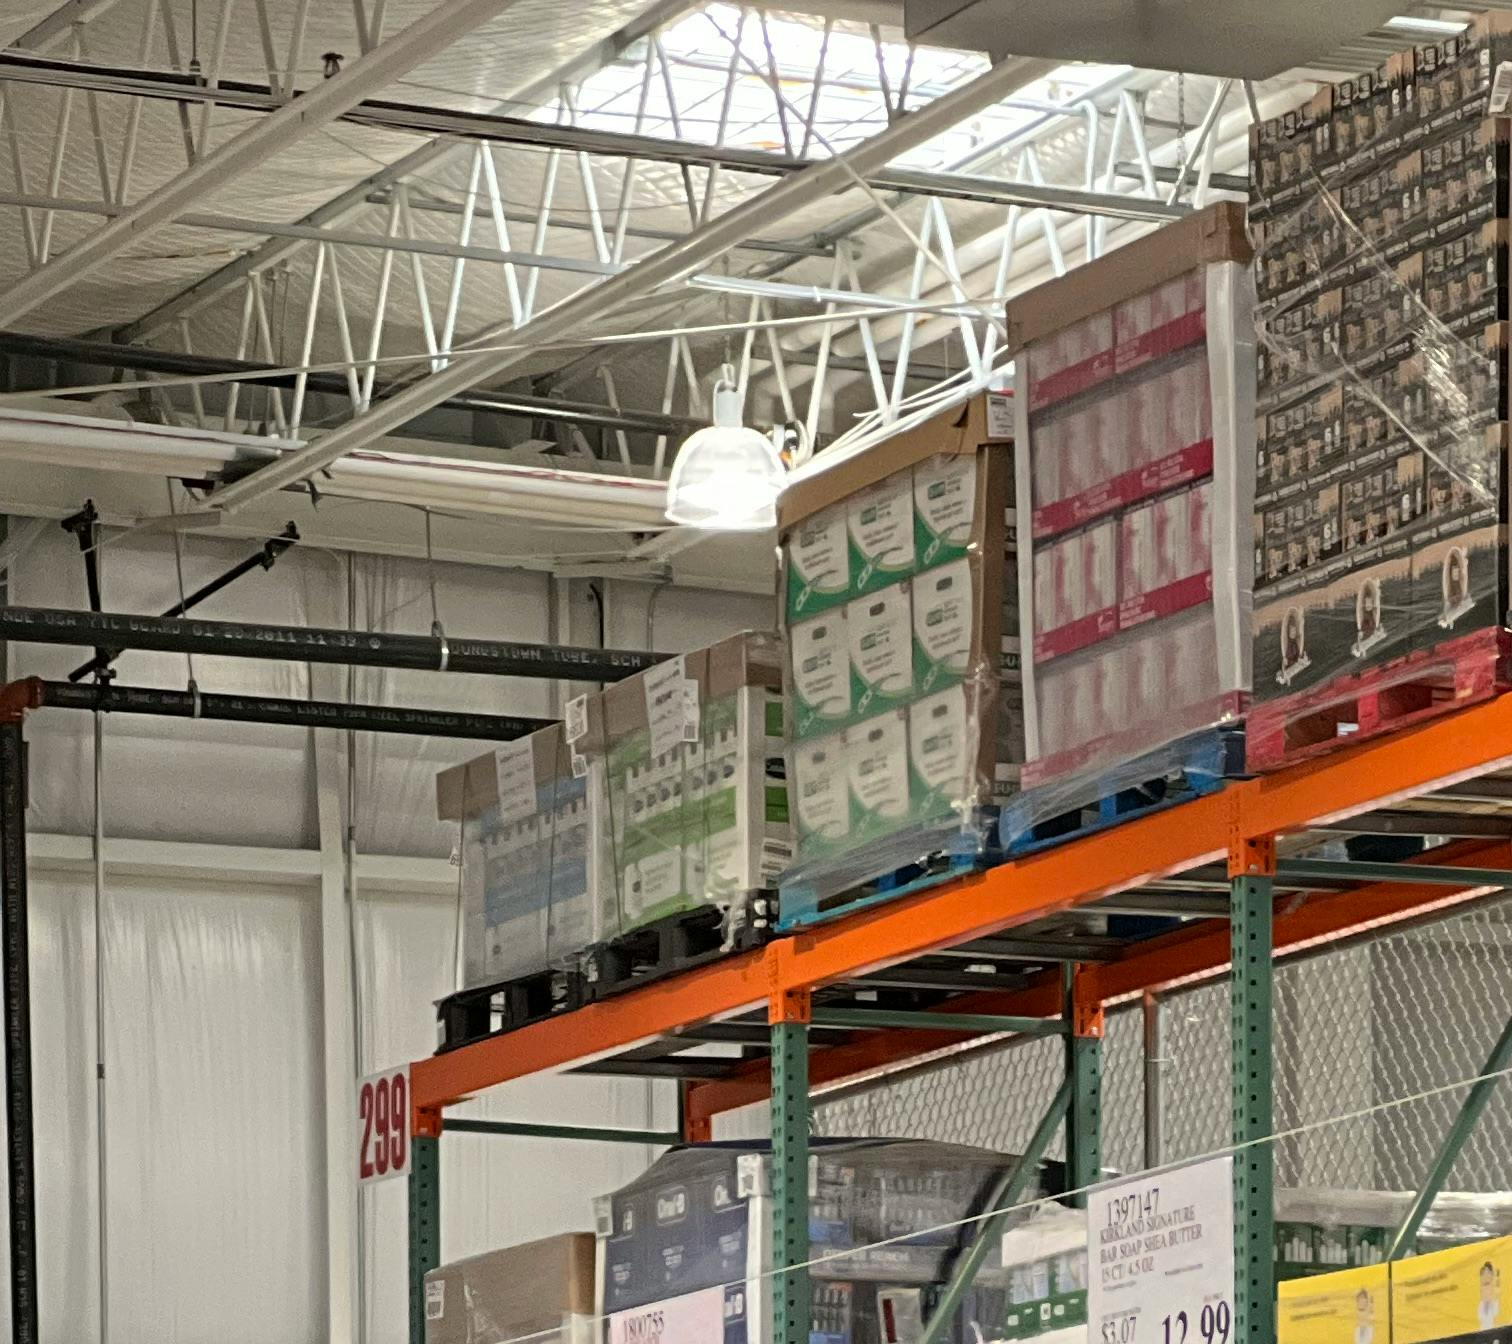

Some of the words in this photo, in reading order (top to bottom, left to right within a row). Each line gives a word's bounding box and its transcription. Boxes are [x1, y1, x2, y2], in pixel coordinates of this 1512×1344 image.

[360, 1073, 406, 1179] 299
[1107, 1188, 1159, 1226] 1397147
[1120, 1240, 1142, 1259] SOAP
[1144, 1233, 1166, 1254] SHEA
[1169, 1224, 1202, 1247] BUTTER
